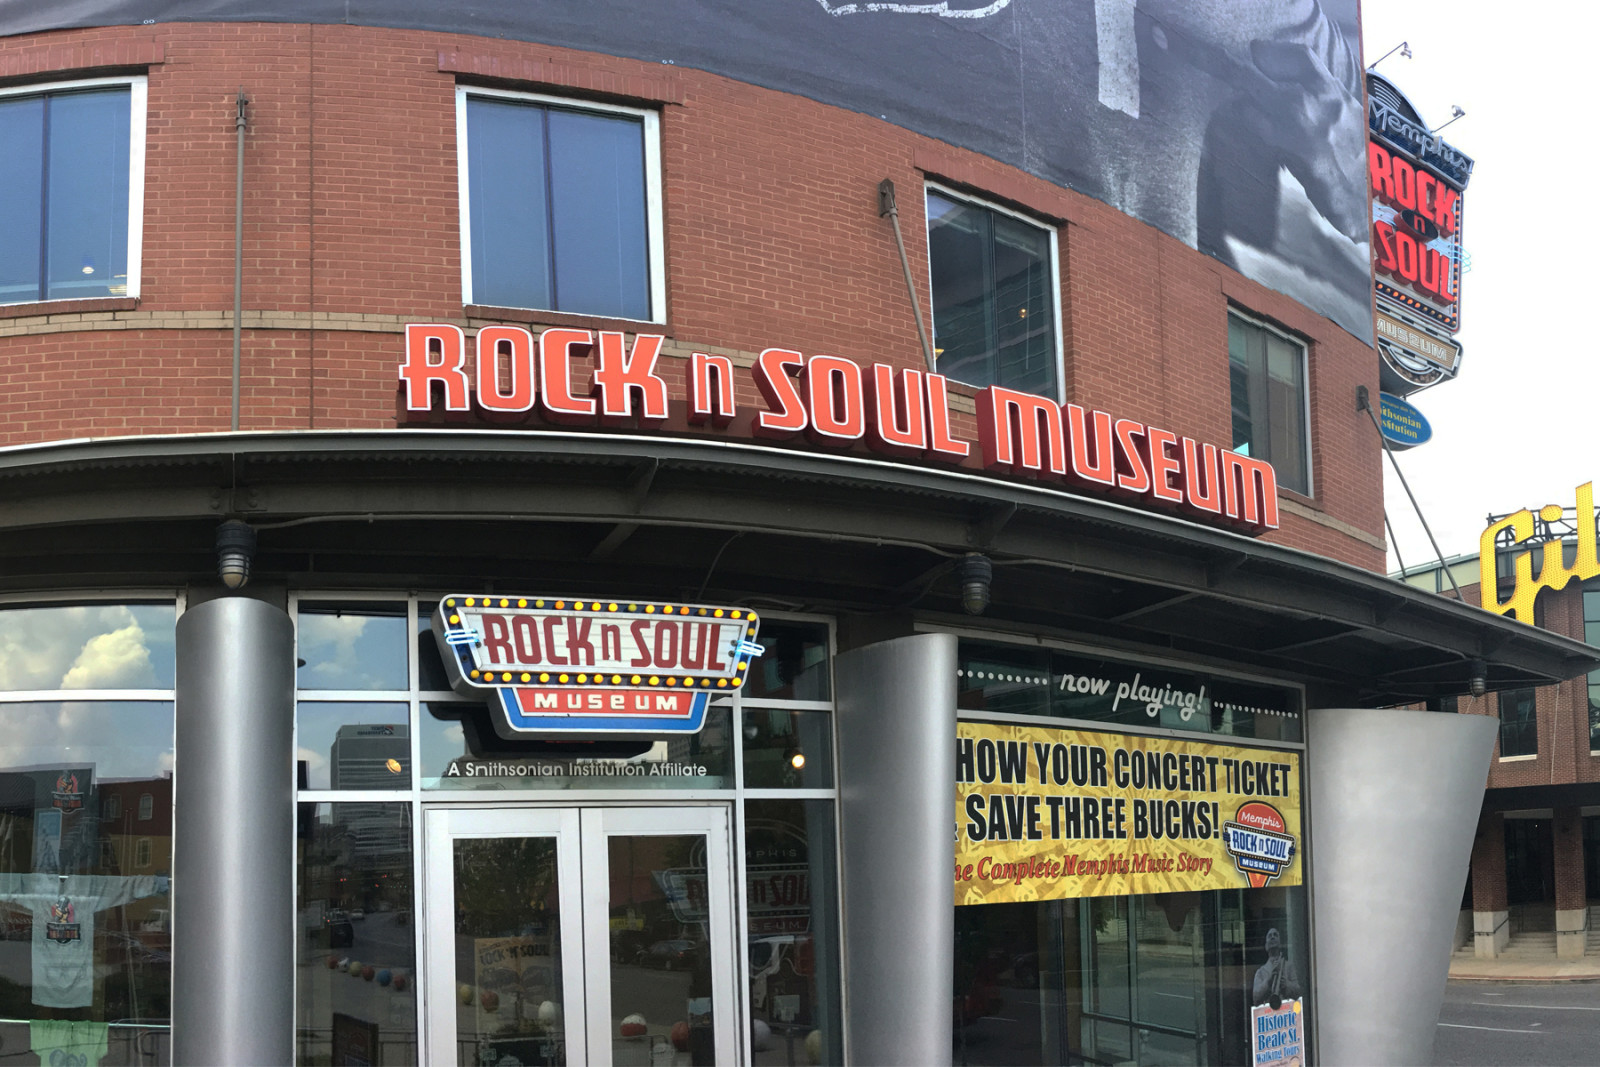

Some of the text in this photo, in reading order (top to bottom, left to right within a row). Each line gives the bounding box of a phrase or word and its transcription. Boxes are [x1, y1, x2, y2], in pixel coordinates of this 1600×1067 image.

[1368, 98, 1468, 172] Memphis
[1369, 141, 1457, 234] ROCK
[1375, 219, 1455, 303] SOUL
[397, 322, 669, 419] ROCK
[756, 346, 970, 456] SOUL
[988, 385, 1280, 531] MUSEUM
[1380, 405, 1422, 429] ithsonian
[481, 613, 594, 667] ROCK
[630, 619, 726, 671] SOUL
[1059, 672, 1206, 722] now playing!
[447, 761, 708, 777] A Smithsonian Institution Affiliate
[1033, 742, 1108, 787] YOUR
[1114, 748, 1219, 793] CONCERT
[1223, 758, 1292, 798] TICKET
[965, 793, 1043, 842] SAVE
[1046, 796, 1127, 841] THREE
[1133, 799, 1220, 841] BUCKS!
[1241, 812, 1281, 829] Memphis
[1232, 831, 1257, 852] ROCK
[1264, 838, 1286, 858] SOUL
[977, 856, 1060, 885] Complete
[1060, 853, 1129, 881] Memphis
[1130, 852, 1174, 875] Music
[1177, 852, 1214, 877] Story
[1257, 1011, 1296, 1033] Historic
[1258, 1027, 1300, 1050] Beale St.
[1256, 1050, 1282, 1064] Walking
